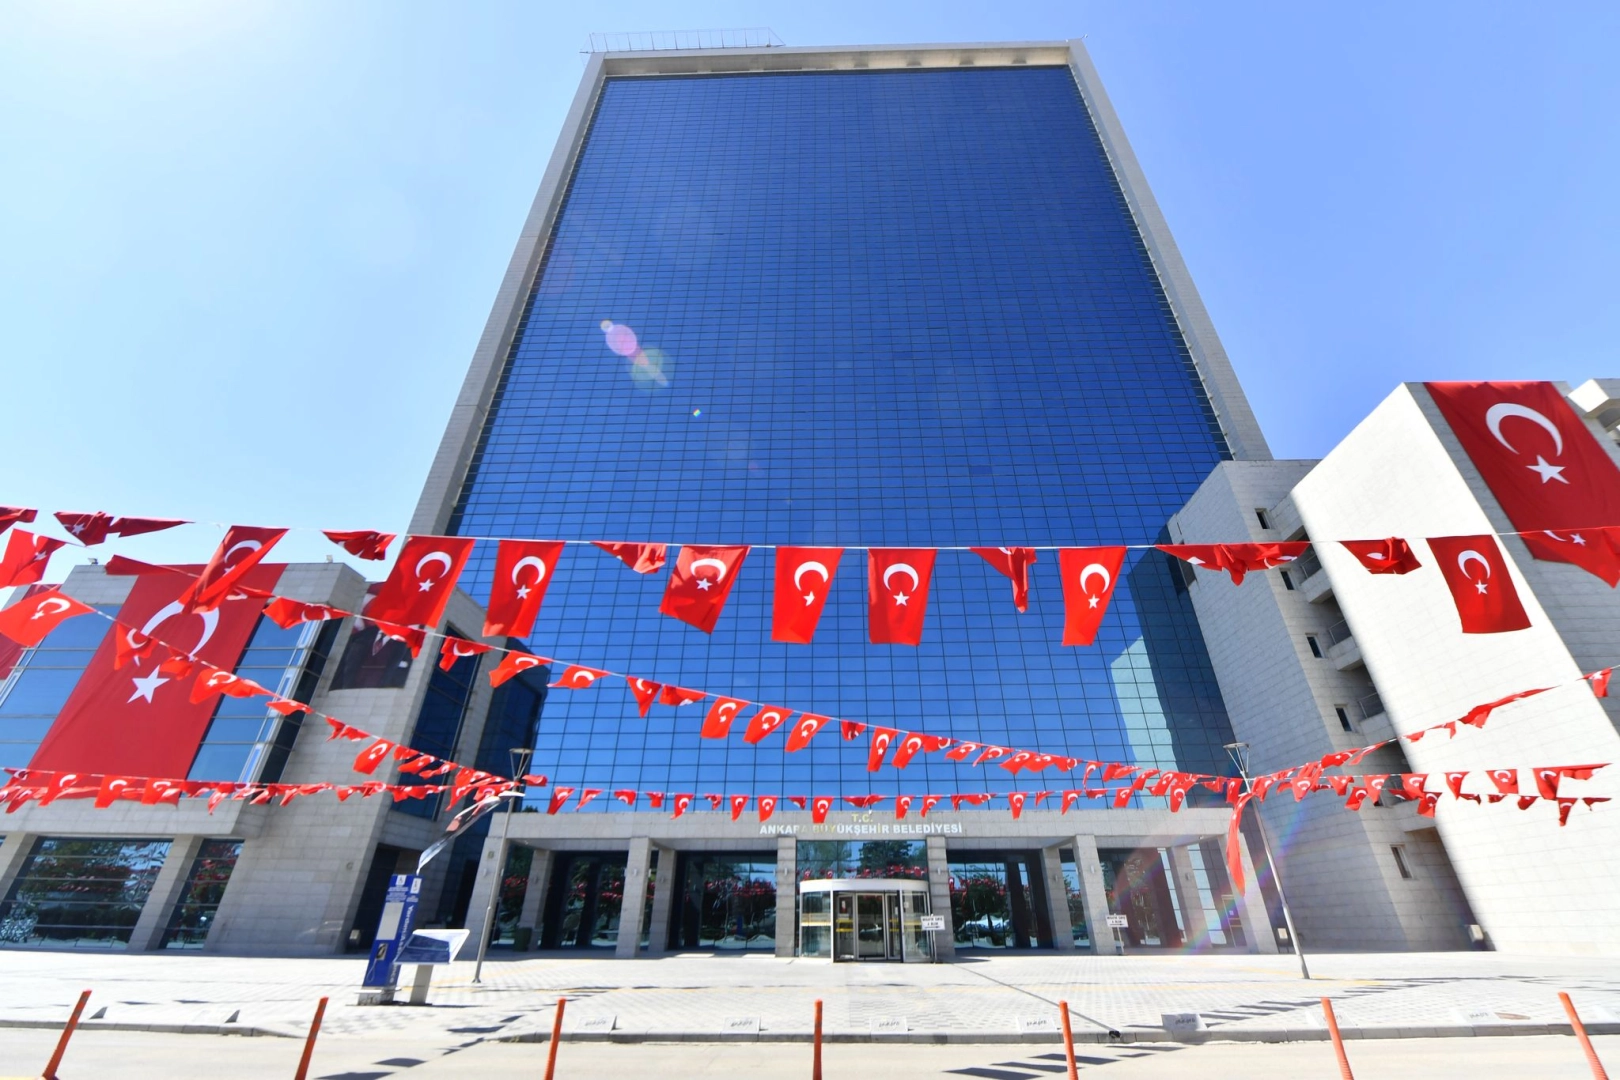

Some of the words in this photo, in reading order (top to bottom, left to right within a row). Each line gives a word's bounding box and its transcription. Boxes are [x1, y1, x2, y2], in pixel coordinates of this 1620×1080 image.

[852, 814, 873, 823] T.C.
[760, 824, 808, 834] ANKARA
[893, 822, 962, 834] BELEDİYESİ
